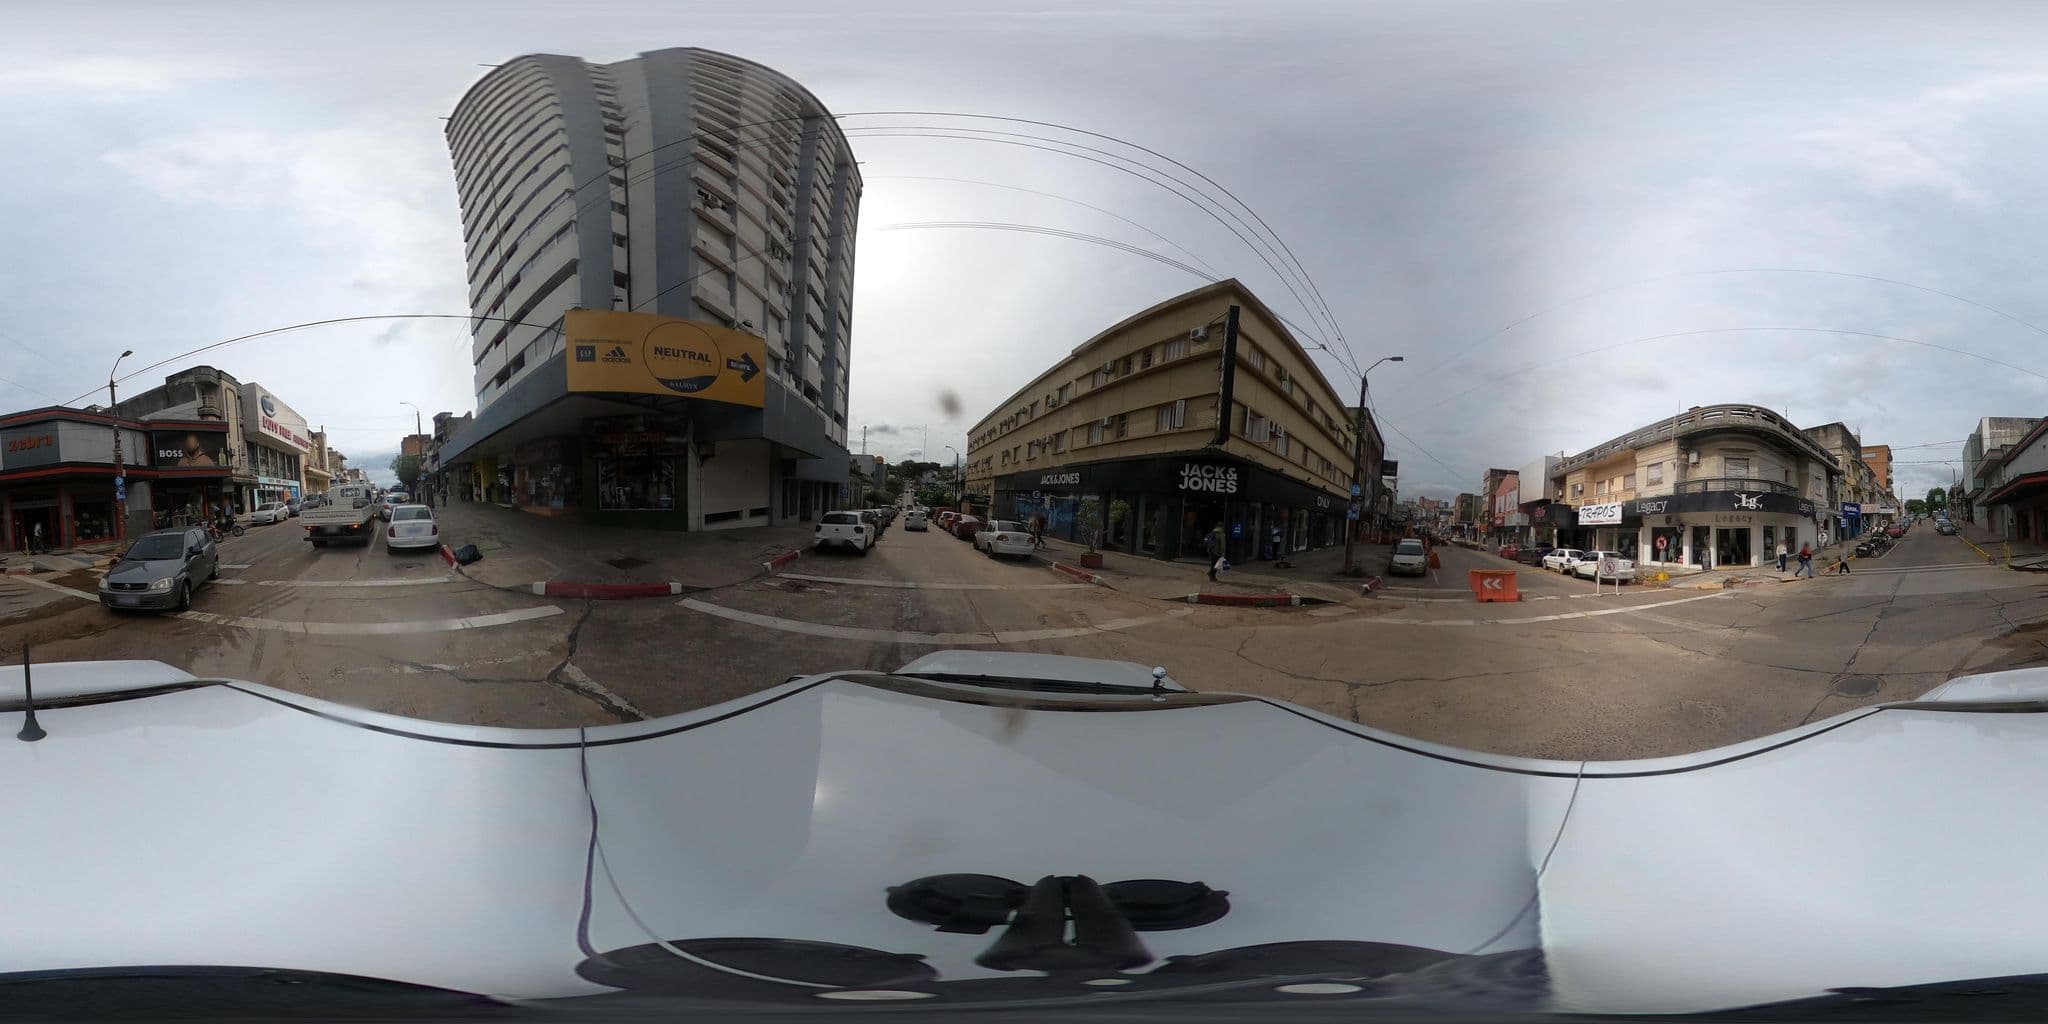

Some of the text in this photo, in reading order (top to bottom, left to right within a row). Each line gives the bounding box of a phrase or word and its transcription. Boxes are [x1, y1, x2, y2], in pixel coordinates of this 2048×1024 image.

[654, 347, 712, 363] NEUTRAL
[1179, 477, 1237, 493] JONES
[1317, 496, 1330, 508] ONLY
[1636, 501, 1668, 514] Legacy
[1580, 505, 1617, 519] TRAPOS
[1716, 515, 1752, 524] Legacy
